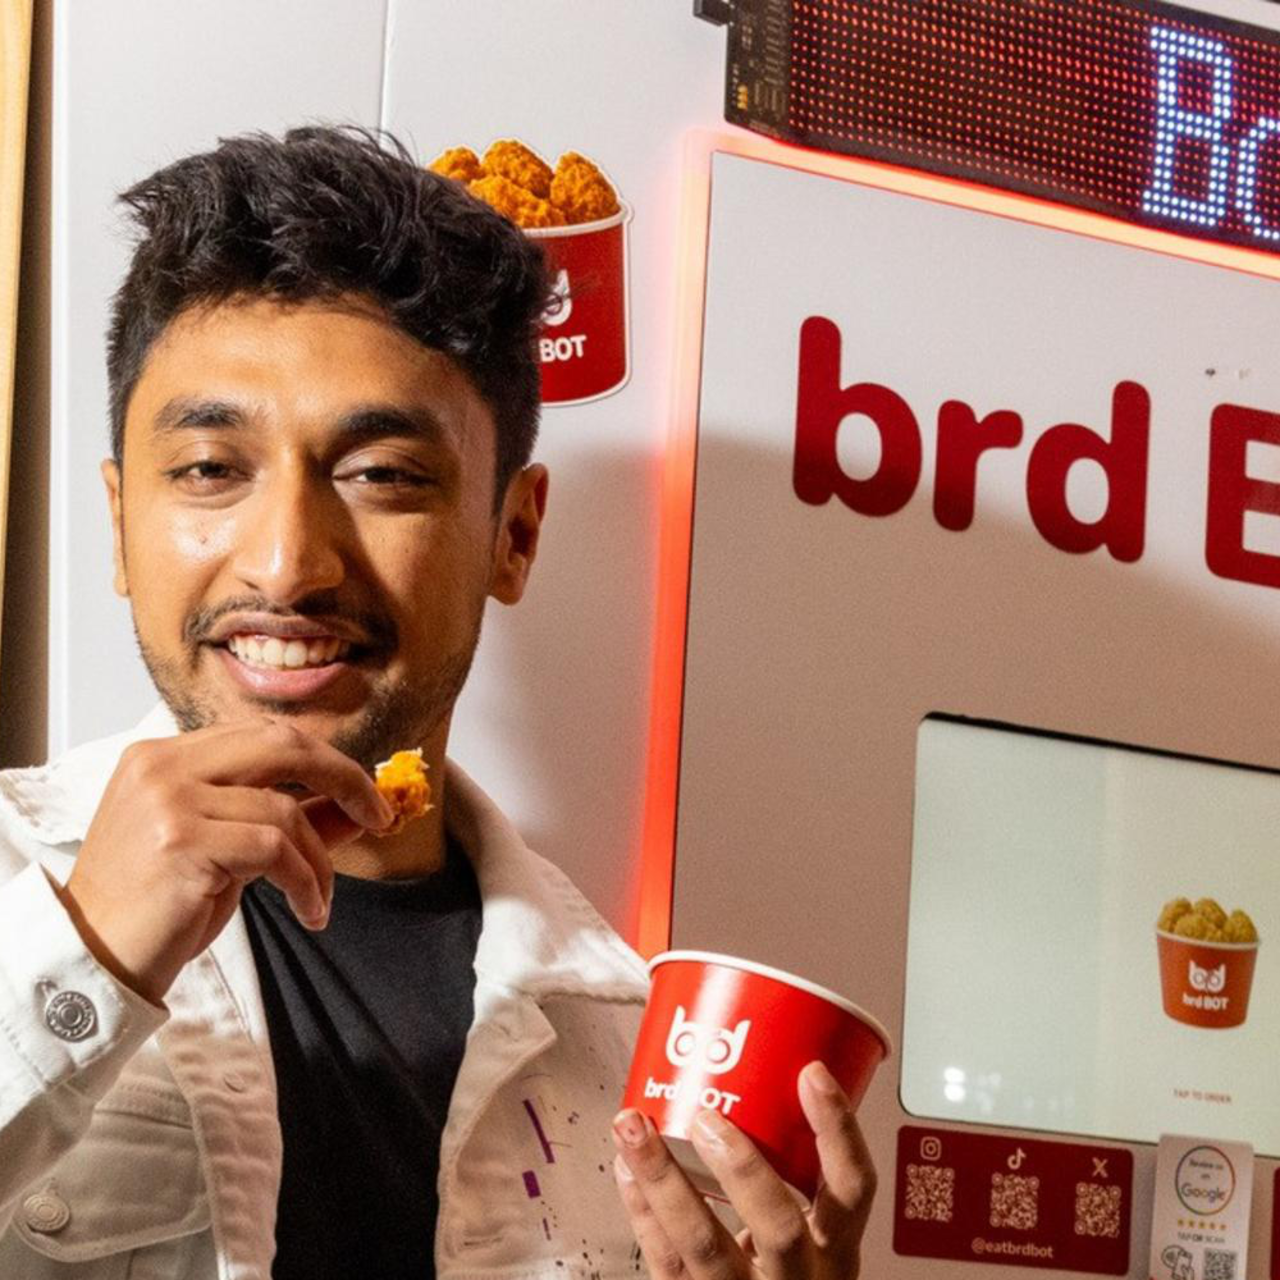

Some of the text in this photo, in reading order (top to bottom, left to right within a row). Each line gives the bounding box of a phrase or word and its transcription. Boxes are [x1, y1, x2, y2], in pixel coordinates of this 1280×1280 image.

[538, 334, 587, 363] BOT
[791, 314, 1151, 564] brd
[1204, 996, 1230, 1011] BOT
[690, 1086, 742, 1116] OT
[1180, 1182, 1227, 1204] Google
[970, 1237, 1055, 1259] @eatbrdbot
